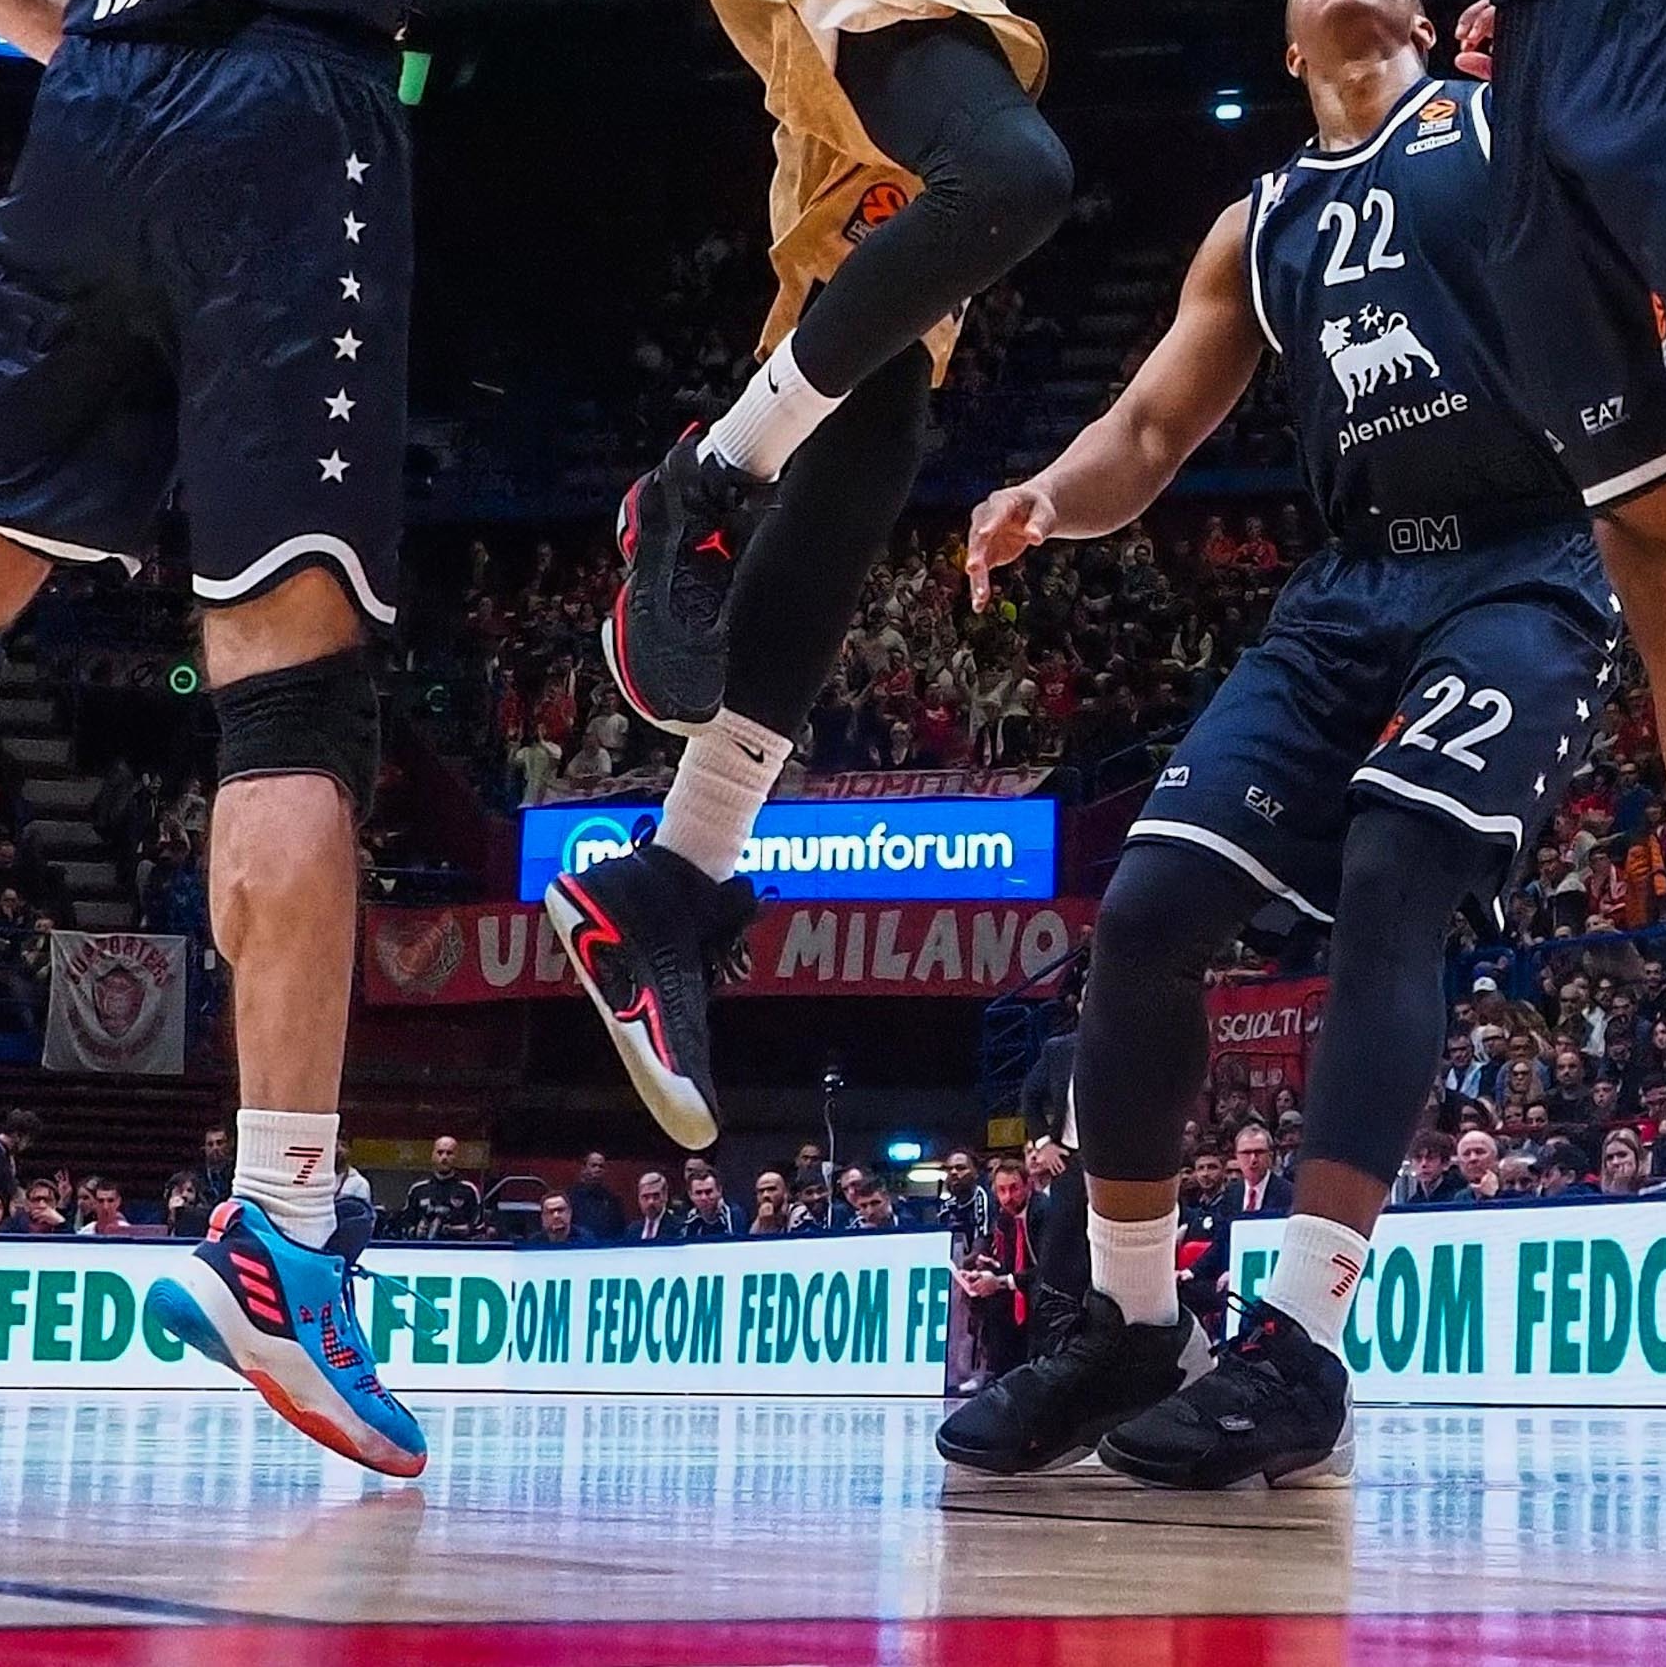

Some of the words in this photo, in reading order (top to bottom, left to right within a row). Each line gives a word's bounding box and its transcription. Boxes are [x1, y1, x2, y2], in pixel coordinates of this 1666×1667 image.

[1317, 187, 1406, 287] 22
[1338, 390, 1470, 456] plenitude
[1580, 394, 1624, 432] EA7
[1388, 514, 1461, 554] OM
[1399, 674, 1513, 772] 22
[1244, 784, 1285, 821] EA7
[569, 819, 1013, 874] manumforum
[775, 908, 1070, 986] MILANO
[585, 1275, 725, 1364] FEDCOM
[737, 1267, 890, 1364] FEDCOM
[905, 1266, 950, 1363] FE
[1240, 1243, 1484, 1374] FCOM
